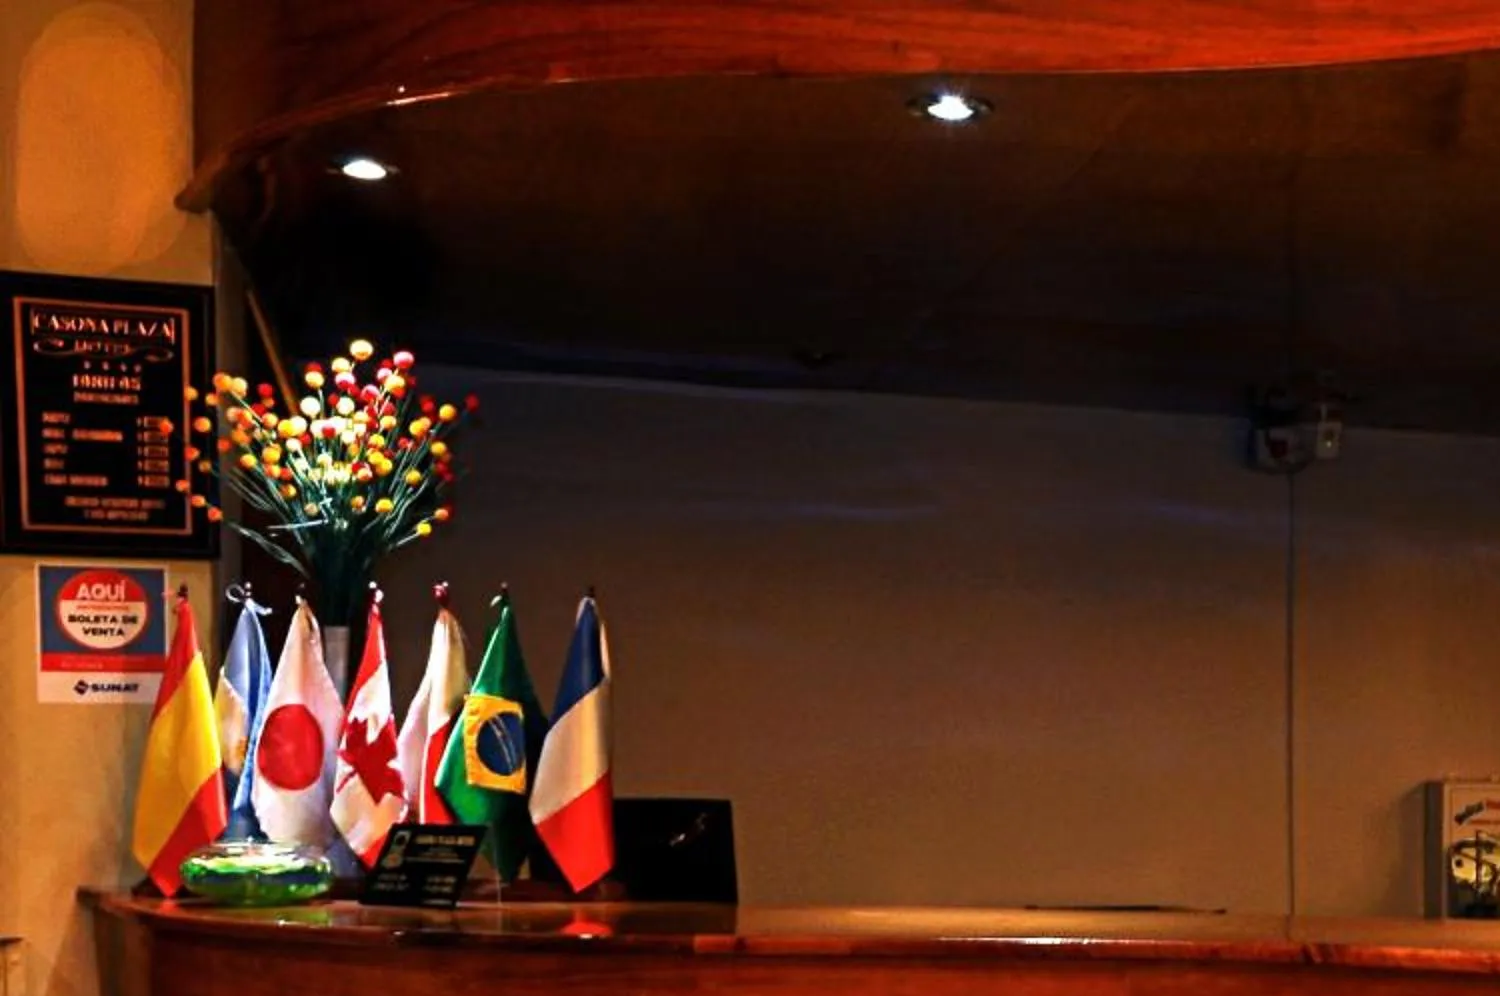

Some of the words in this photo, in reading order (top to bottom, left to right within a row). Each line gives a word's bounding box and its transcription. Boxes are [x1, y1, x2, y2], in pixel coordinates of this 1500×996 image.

[76, 579, 126, 600] AQUÍ
[67, 614, 118, 624] BOLETA
[121, 614, 138, 625] DE
[82, 626, 125, 637] VENTA
[91, 682, 139, 693] SUNAT
